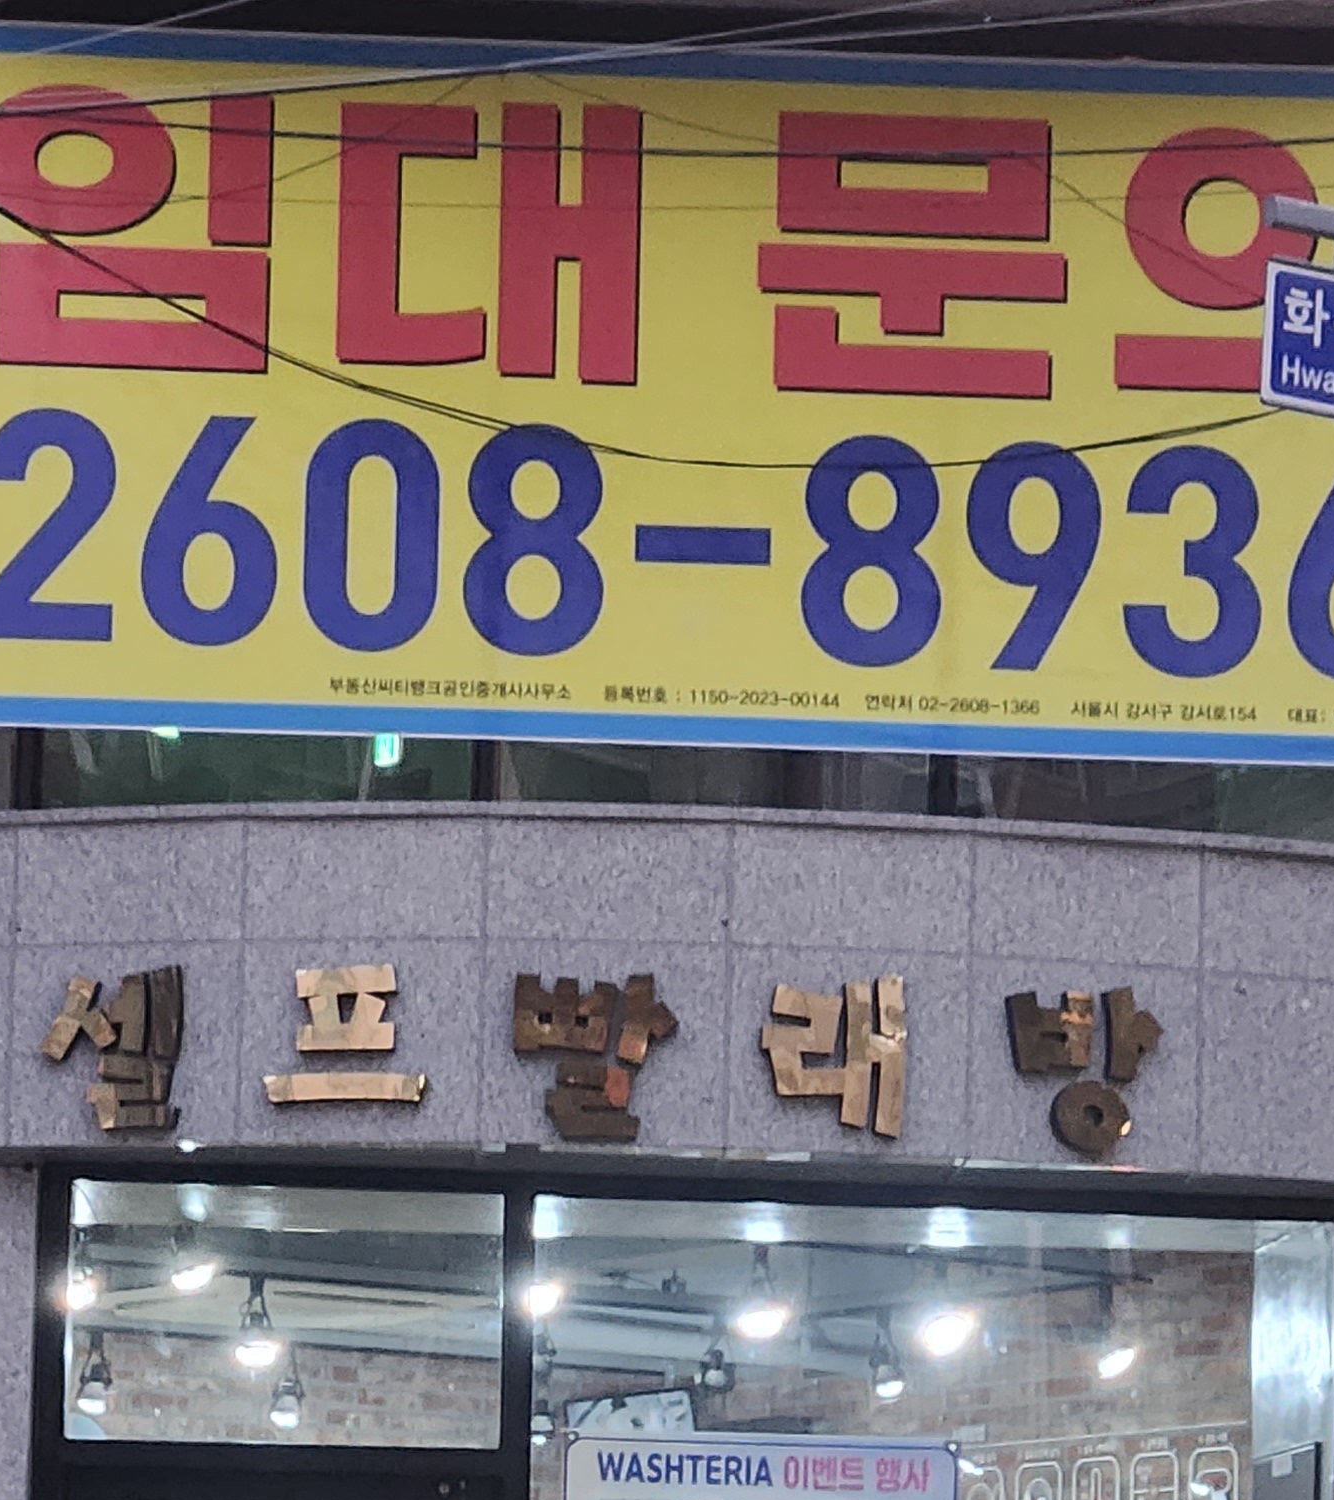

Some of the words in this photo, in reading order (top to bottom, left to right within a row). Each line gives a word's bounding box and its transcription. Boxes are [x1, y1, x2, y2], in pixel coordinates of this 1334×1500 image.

[689, 688, 841, 709] 1150-2023-00144
[864, 692, 913, 712] 연락처
[1070, 700, 1119, 718] 서울시
[39, 963, 1165, 1155] 셀프빨래방
[597, 1450, 773, 1487] WASHTERIA
[783, 1455, 865, 1491] 이벤트
[875, 1457, 930, 1493] 행사
